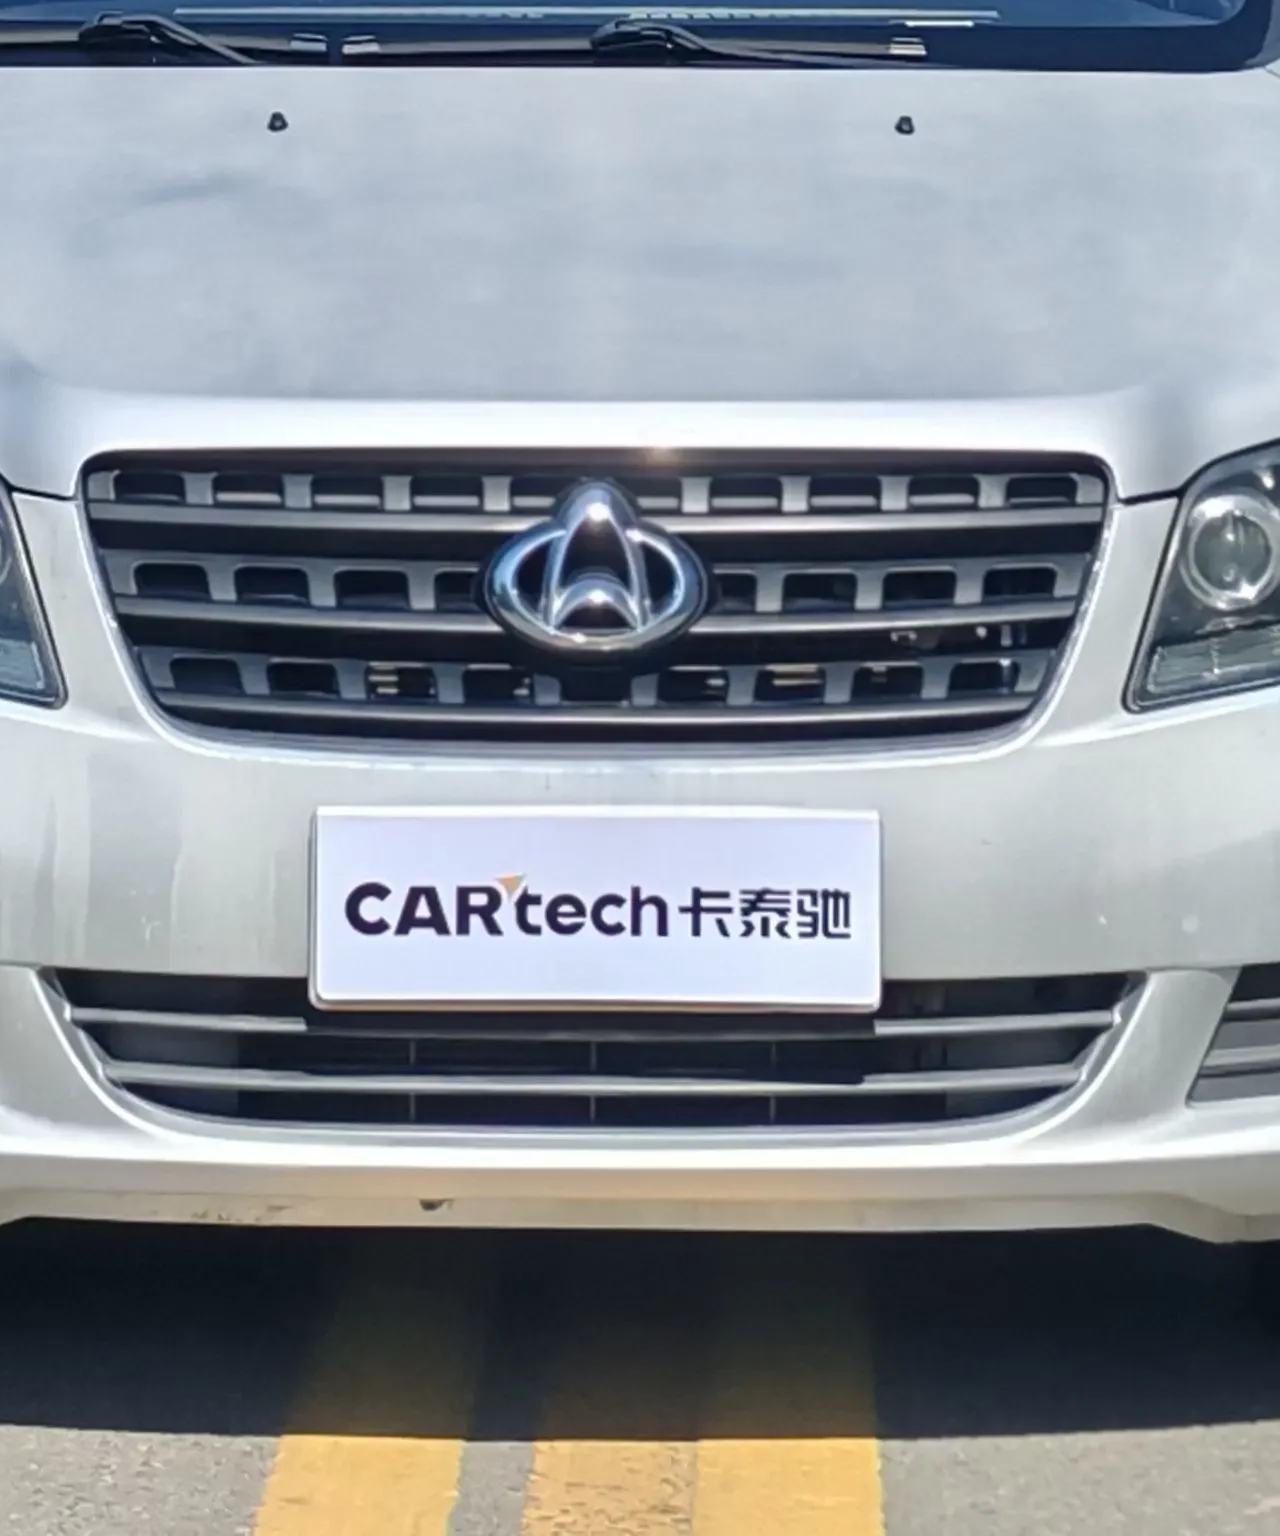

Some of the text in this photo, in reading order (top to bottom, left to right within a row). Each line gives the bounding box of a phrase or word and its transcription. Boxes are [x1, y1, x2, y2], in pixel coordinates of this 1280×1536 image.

[344, 881, 852, 940] CARtech 卡泰驰
